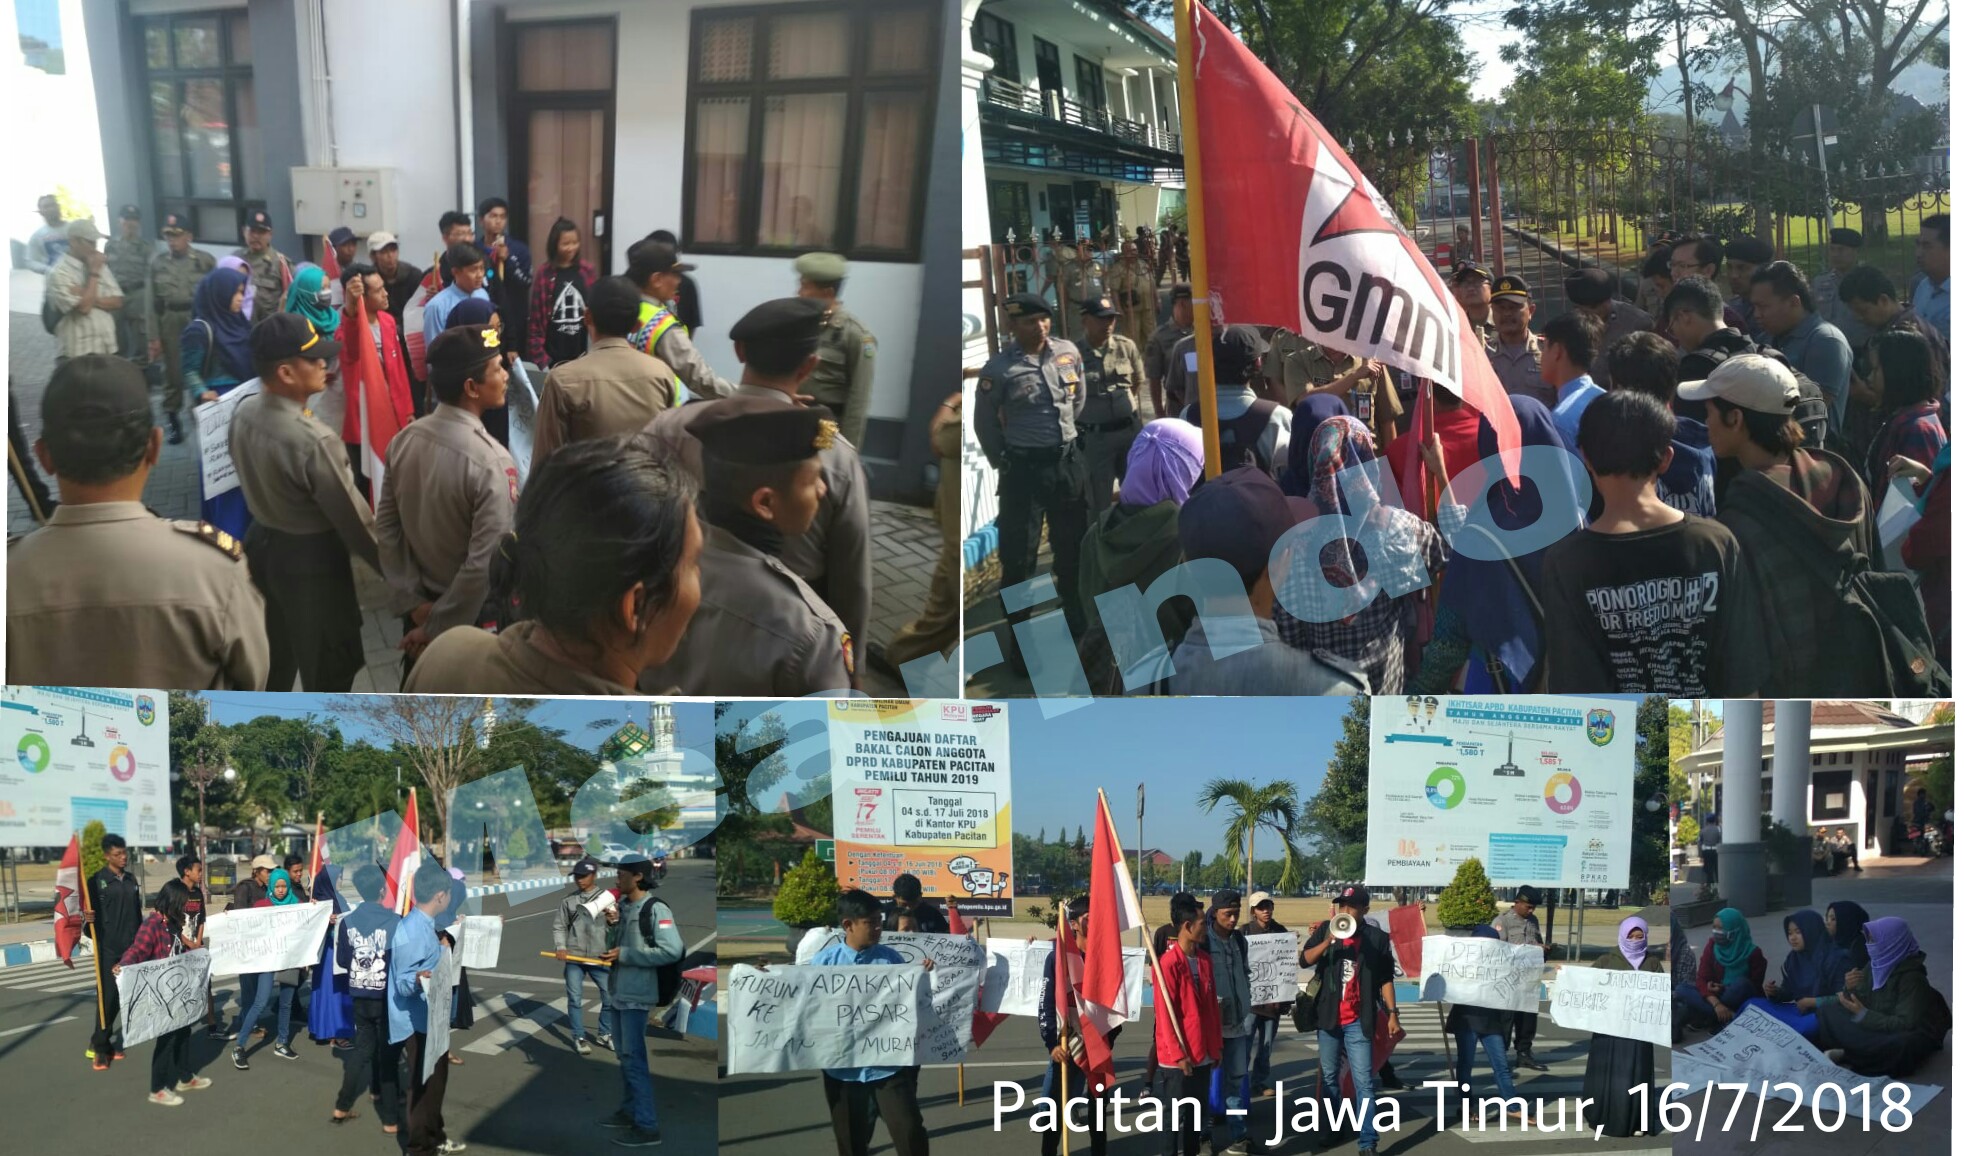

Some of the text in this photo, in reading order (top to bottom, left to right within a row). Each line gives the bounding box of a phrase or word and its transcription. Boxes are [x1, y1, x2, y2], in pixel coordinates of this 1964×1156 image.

[1303, 260, 1456, 383] Gmni
[1585, 577, 1682, 613] PONOROGO
[943, 705, 965, 714] KPU
[1448, 699, 1582, 716] IKHTISAR APBD KABUPATEN PACITAN
[1449, 710, 1485, 718] TAHUN
[1492, 712, 1549, 722] ANGGARAN
[864, 730, 977, 746] PENGAJUAN DAFTAR
[855, 743, 986, 759] BAKAL CALON ANGGOTA
[846, 755, 995, 773] DPRD KABUPATEN PACITAN
[865, 770, 979, 785] PEMILU TAHUN 2019
[928, 796, 962, 808] Tanggal
[901, 807, 989, 818] 04 s.d. 17 Juli 2018
[915, 818, 977, 829] di Kantor KPU
[905, 829, 987, 841] Kabupaten Pacitan
[848, 851, 871, 859] Dengan
[1387, 859, 1431, 868] PEMBIAYAAN
[859, 876, 881, 884] Tanggal
[810, 973, 915, 995] ADAKAN
[1558, 988, 1610, 1012] CEKIK
[746, 1000, 910, 1026] KE PASAR
[744, 1030, 920, 1055] JALAN MURAH
